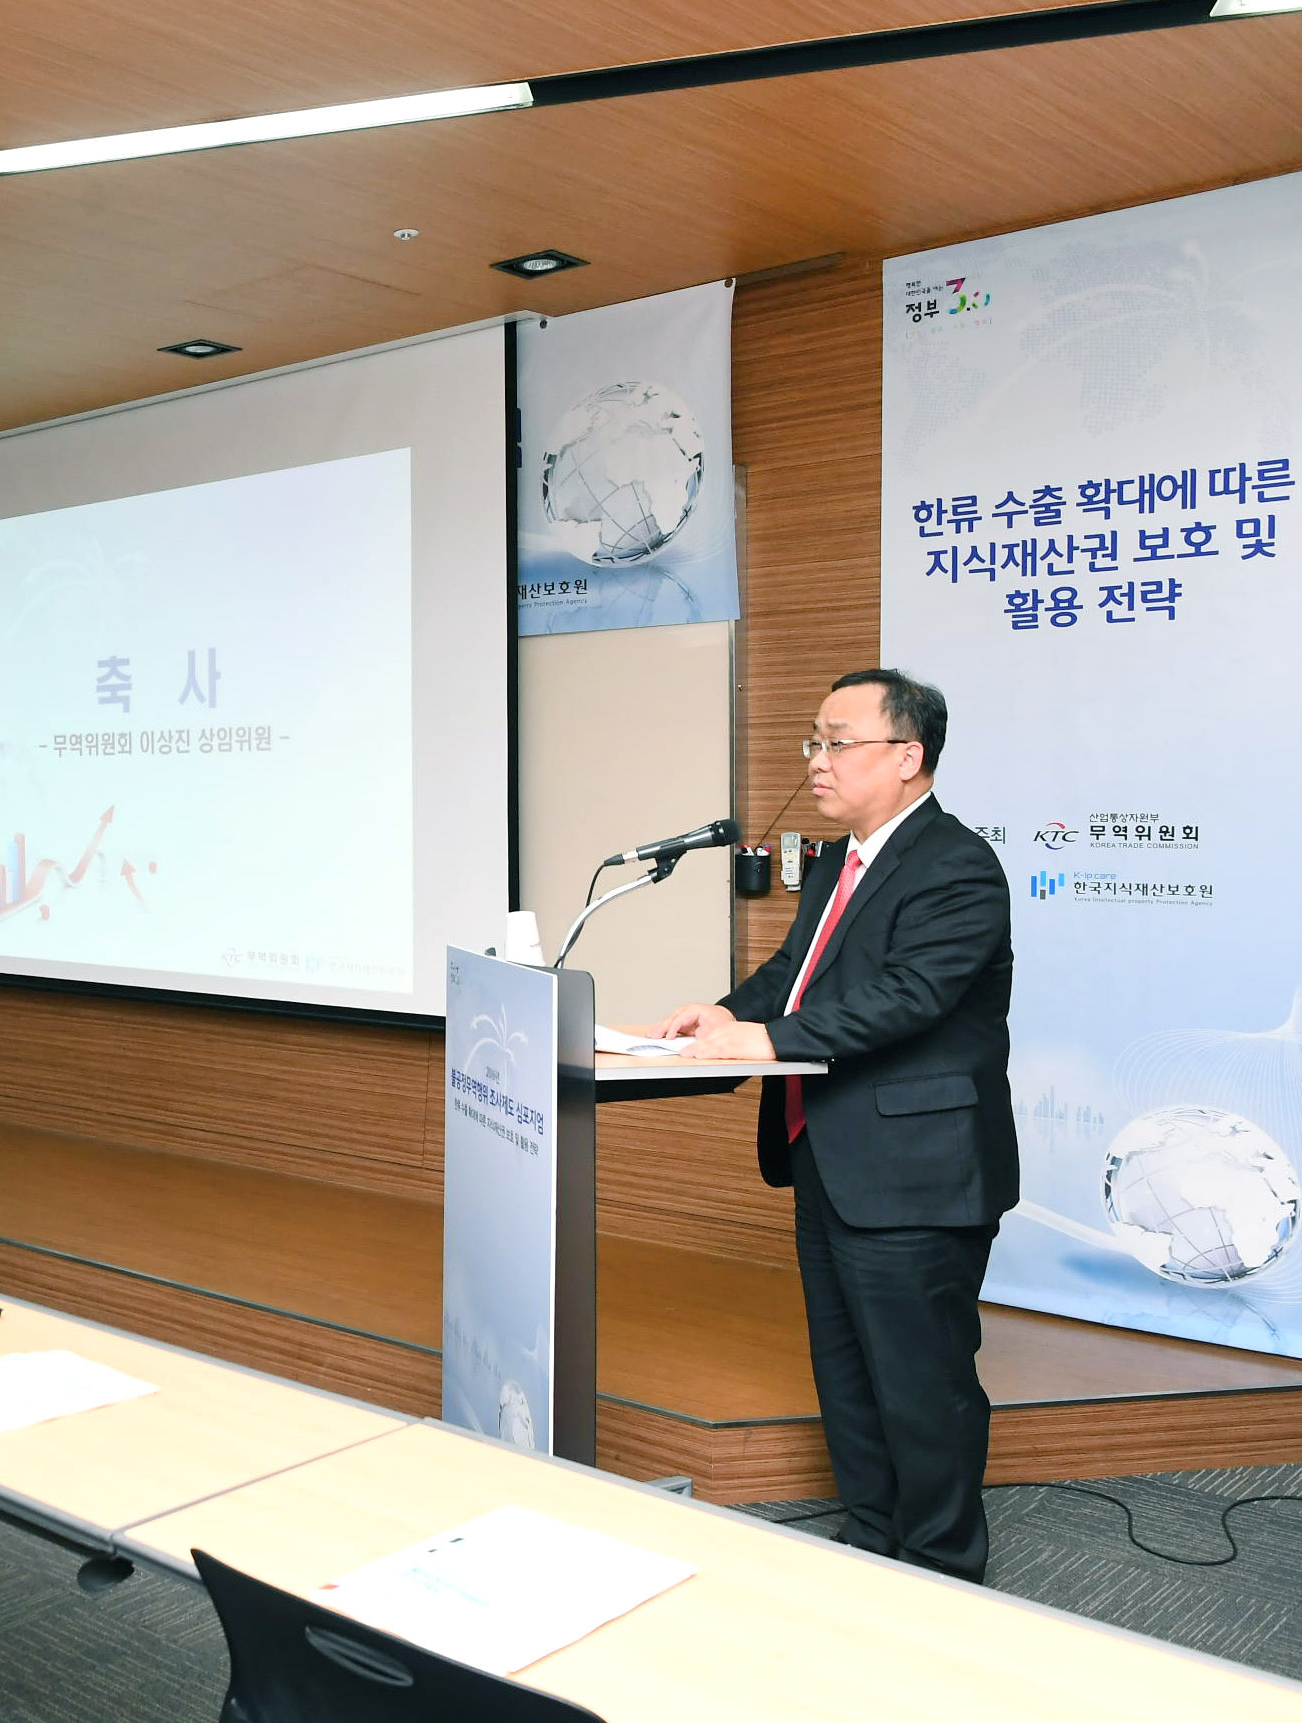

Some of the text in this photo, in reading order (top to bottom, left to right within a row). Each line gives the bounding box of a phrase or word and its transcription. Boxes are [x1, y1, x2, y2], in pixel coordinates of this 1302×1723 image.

[905, 299, 940, 323] 정부
[912, 458, 1296, 538] 한류 수출 확대에 따른
[925, 513, 1277, 584] 지식재산권 보호 및
[1003, 576, 1183, 631] 활용 전략
[96, 647, 222, 713] 축 사
[53, 731, 133, 757] 무역위원회
[139, 729, 191, 755] 이상진
[197, 724, 272, 753] 상임위원
[1089, 812, 1160, 824] 산업통상자원부
[1089, 825, 1200, 842] 무역위원회
[1033, 829, 1080, 843] KTC
[1073, 881, 1214, 899] 한국지식재산보호원
[489, 1089, 515, 1116] 조사제도
[516, 1102, 544, 1135] 심포지엄
